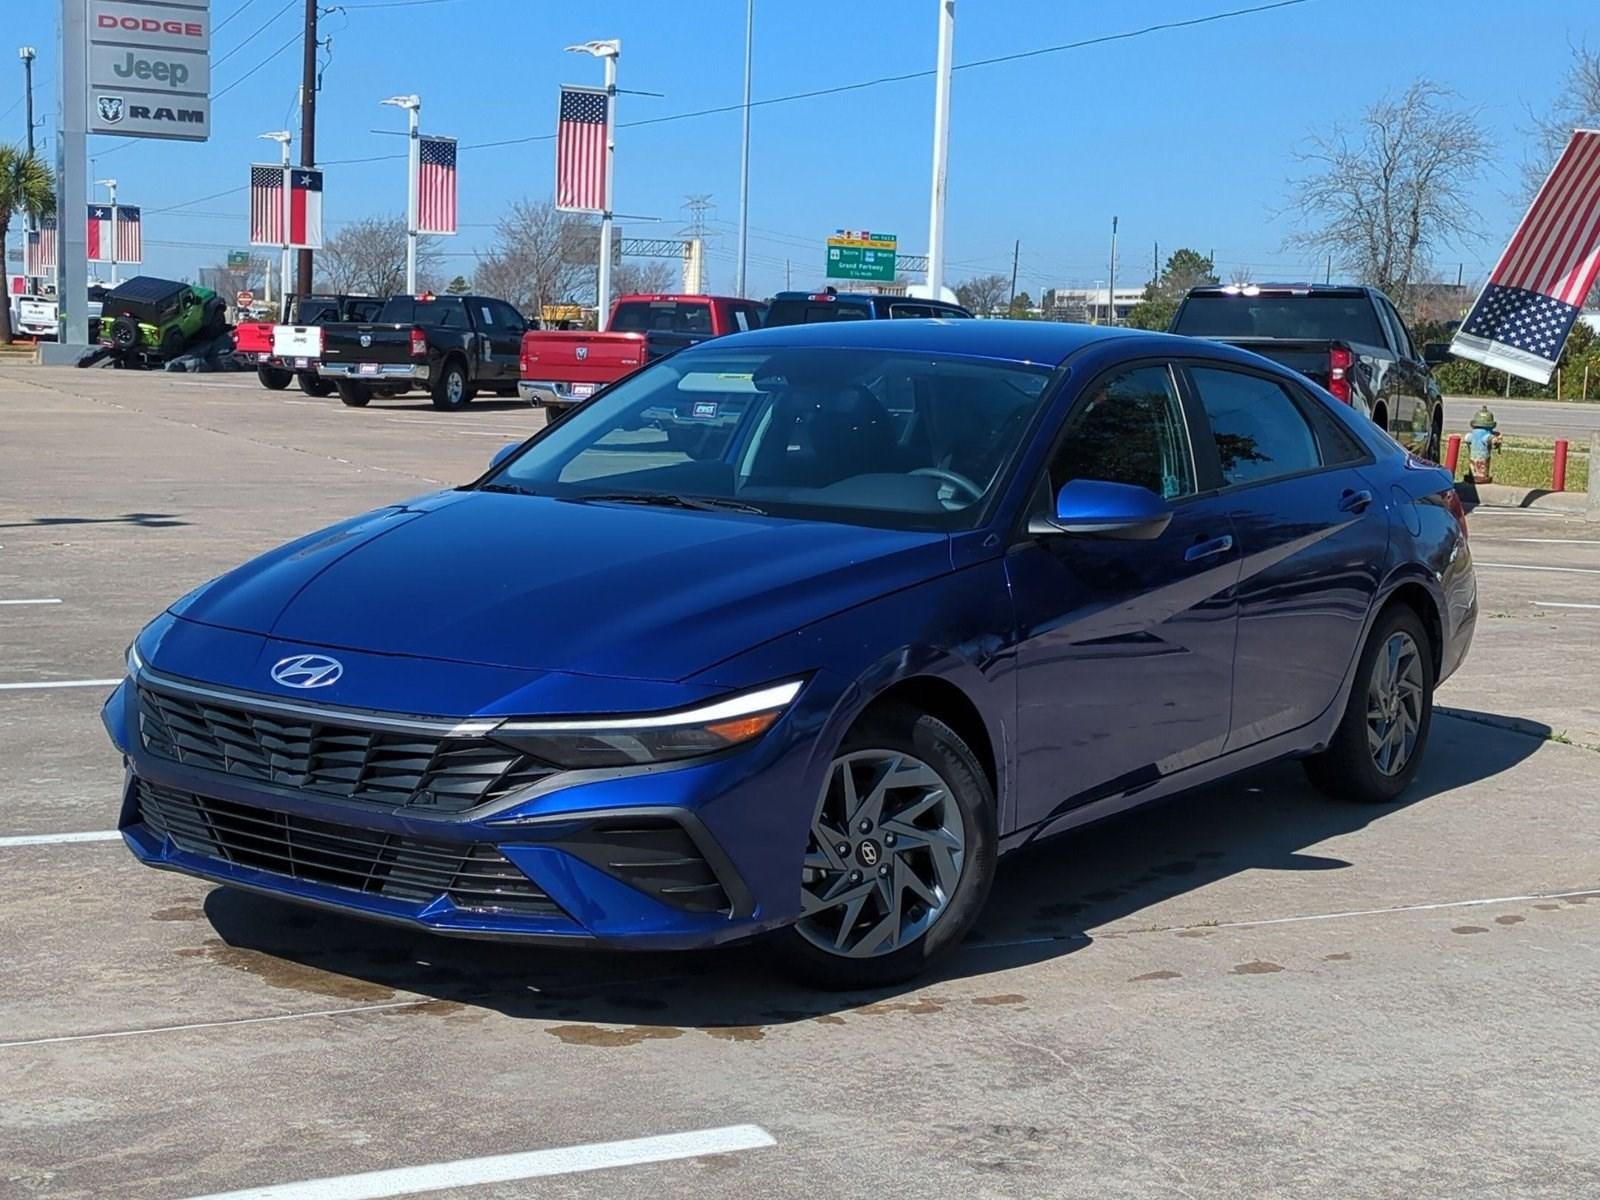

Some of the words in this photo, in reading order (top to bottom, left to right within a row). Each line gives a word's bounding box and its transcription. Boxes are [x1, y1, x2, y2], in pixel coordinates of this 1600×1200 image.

[98, 15, 203, 37] DODGE
[113, 52, 189, 87] Jeep
[129, 105, 204, 124] RAM
[838, 262, 857, 270] Grand
